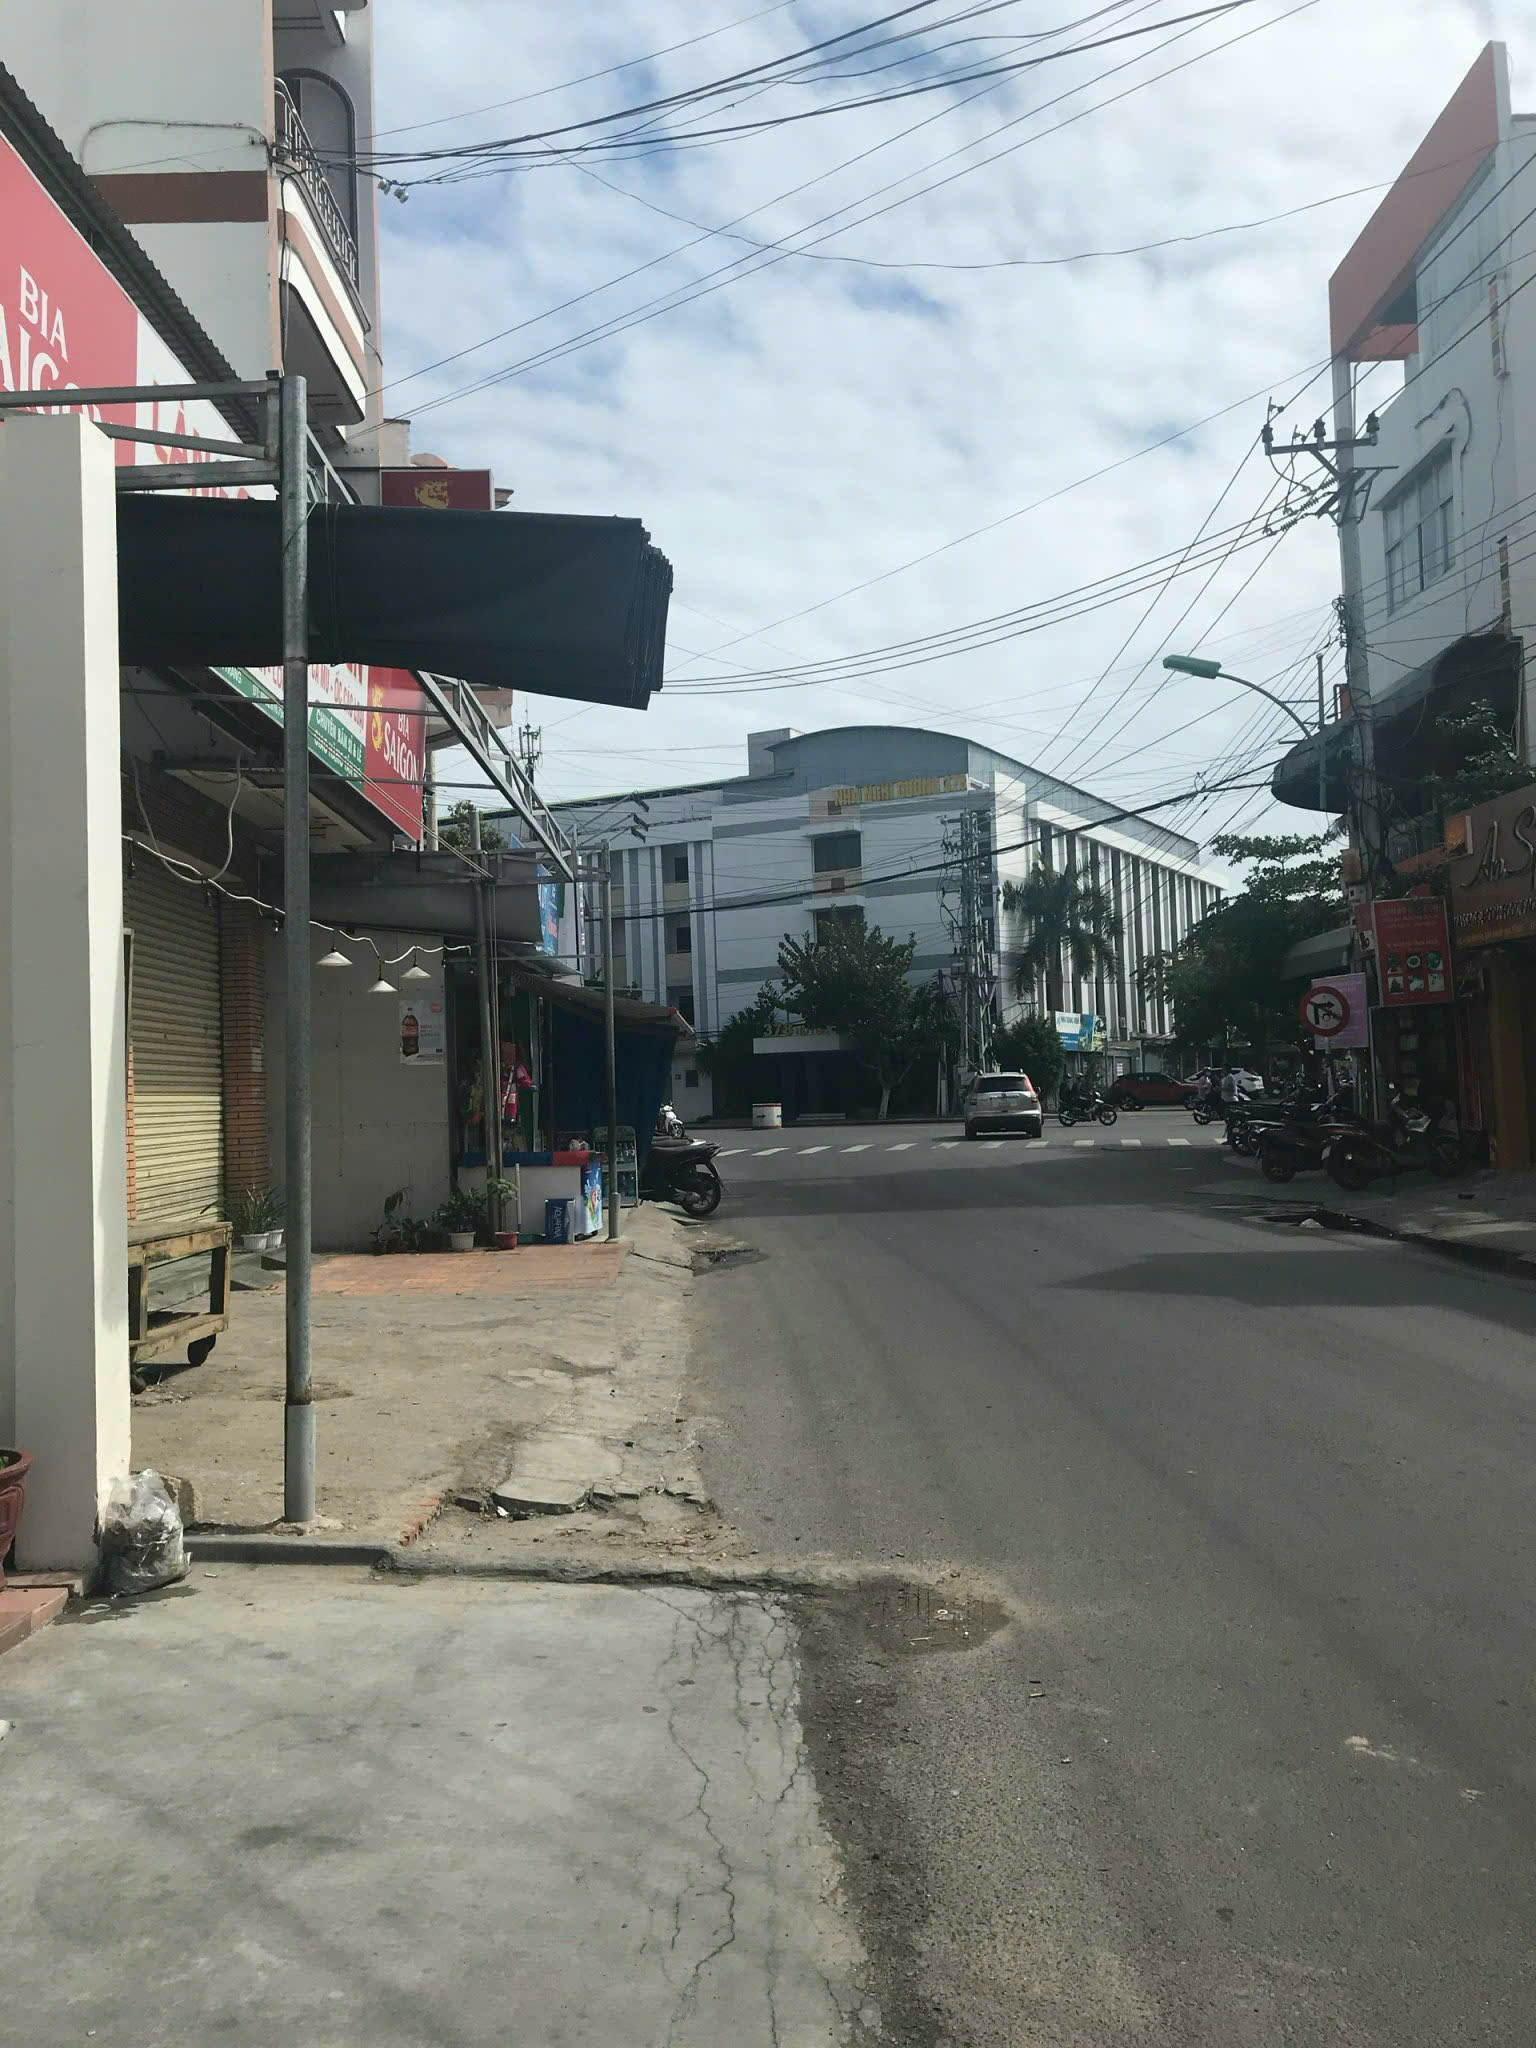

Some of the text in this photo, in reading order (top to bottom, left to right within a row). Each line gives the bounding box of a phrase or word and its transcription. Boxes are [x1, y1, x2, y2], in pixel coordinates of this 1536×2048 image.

[19, 264, 69, 363] BIA
[316, 708, 337, 741] CHUYÊN
[337, 727, 348, 748] BÁN
[398, 713, 410, 741] BIA
[383, 721, 420, 793] SAIGON
[552, 1206, 564, 1239] AQUAFINA
